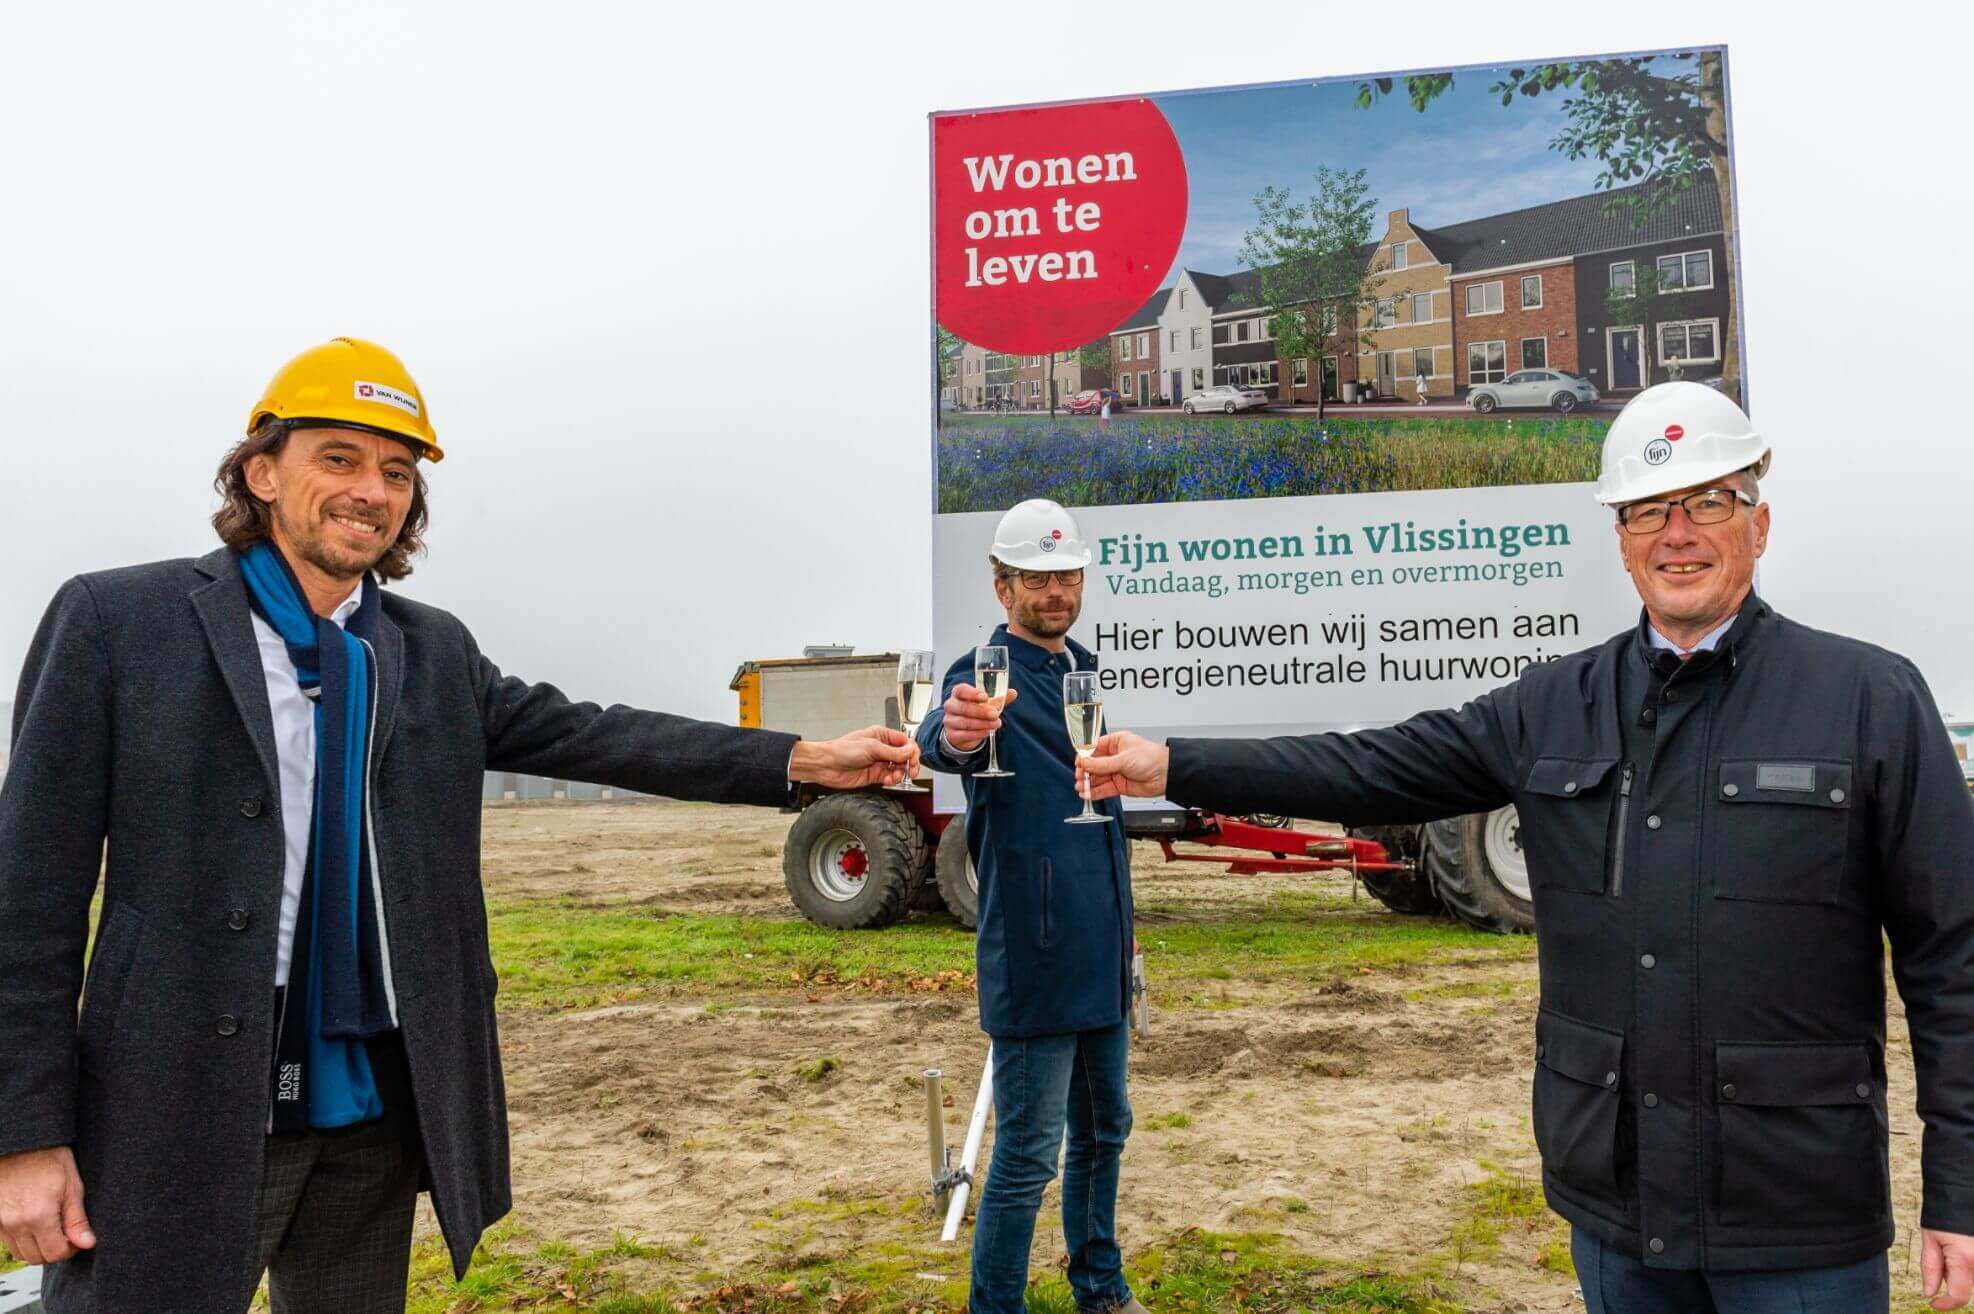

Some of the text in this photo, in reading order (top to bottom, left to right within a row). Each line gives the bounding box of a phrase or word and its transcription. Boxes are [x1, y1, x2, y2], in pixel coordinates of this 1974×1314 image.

[963, 151, 1136, 192] Wonen
[965, 198, 1101, 240] om te
[965, 248, 1098, 287] leven
[1098, 518, 1571, 573] Fijn wonen in Vlissingen
[1106, 560, 1564, 598] Vandaag, morgen en overmorgen
[1096, 612, 1579, 651] Hier bouwen wij samen aan
[1100, 653, 1367, 696] energieneutrale
[278, 1063, 293, 1101] BOSS
